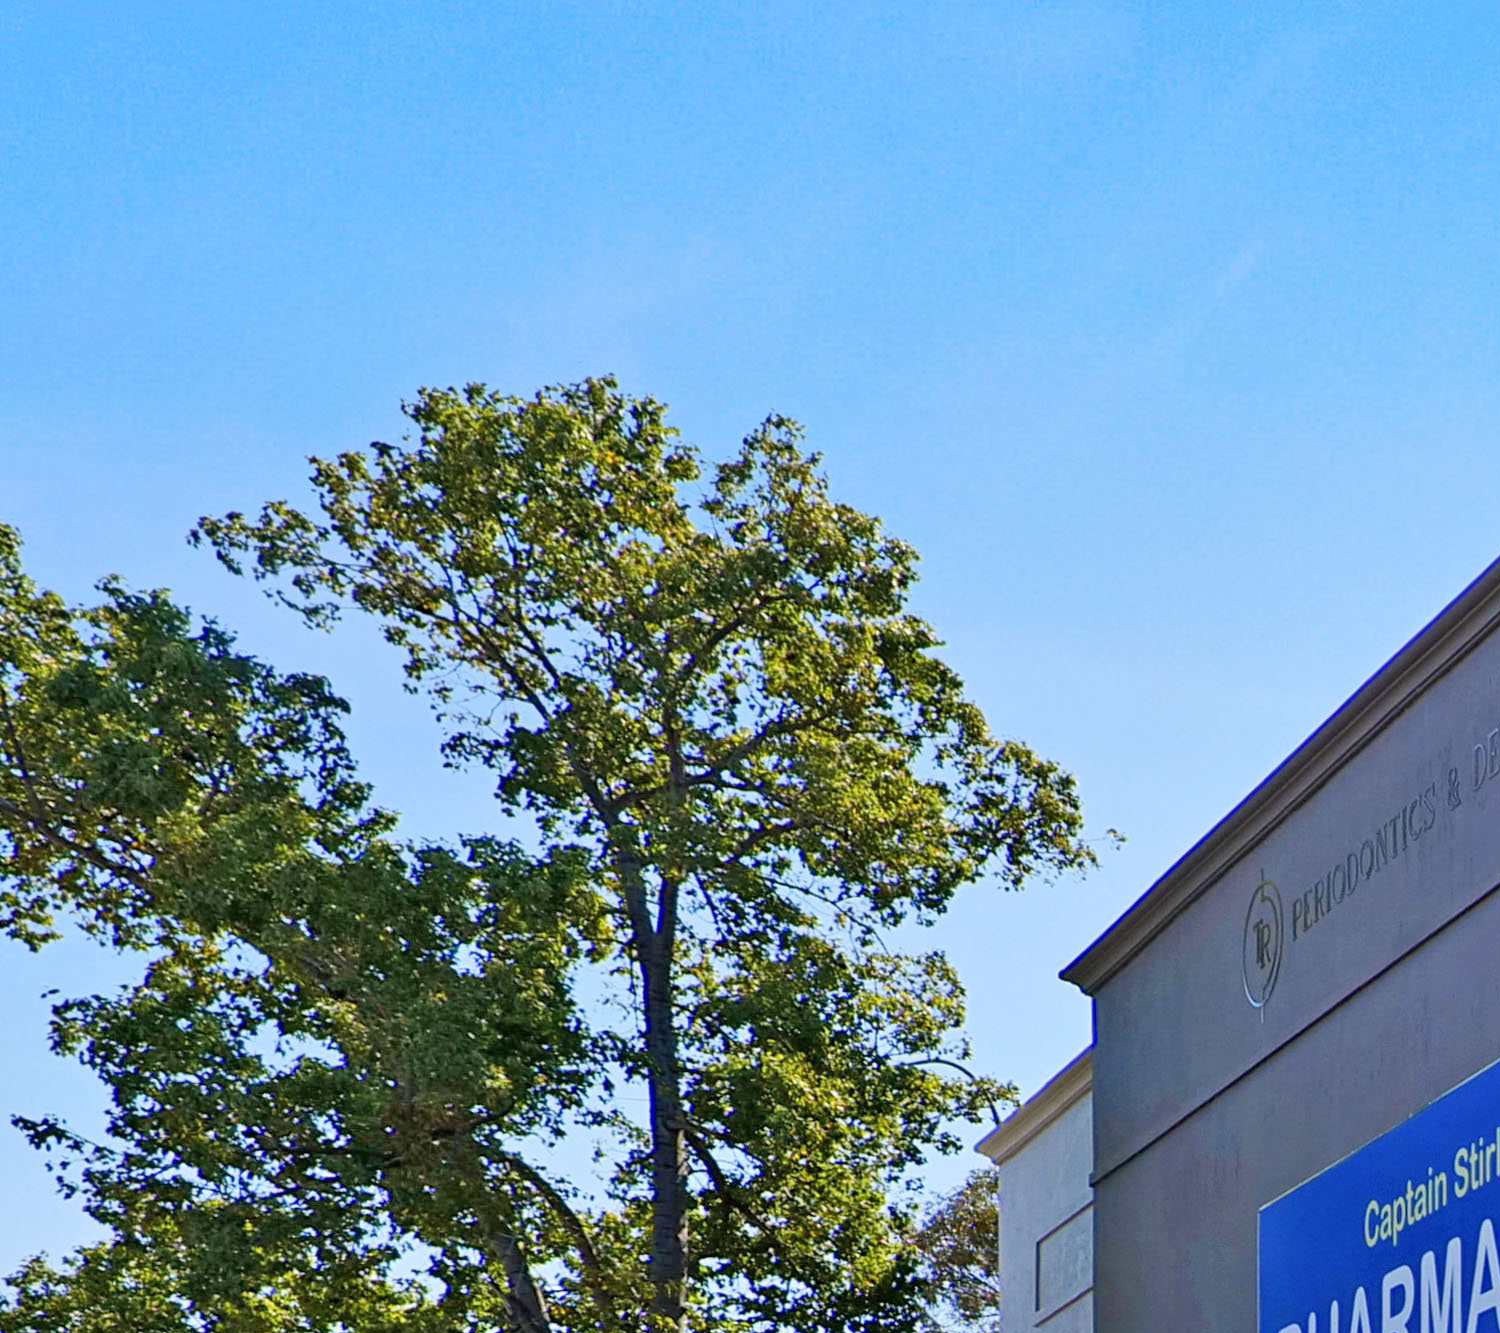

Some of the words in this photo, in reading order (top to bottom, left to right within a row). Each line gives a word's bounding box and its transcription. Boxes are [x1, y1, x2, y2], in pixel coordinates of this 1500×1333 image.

[1291, 782, 1436, 942] PERIODONTICS
[1446, 767, 1462, 812] &
[1364, 1166, 1448, 1247] Captain
